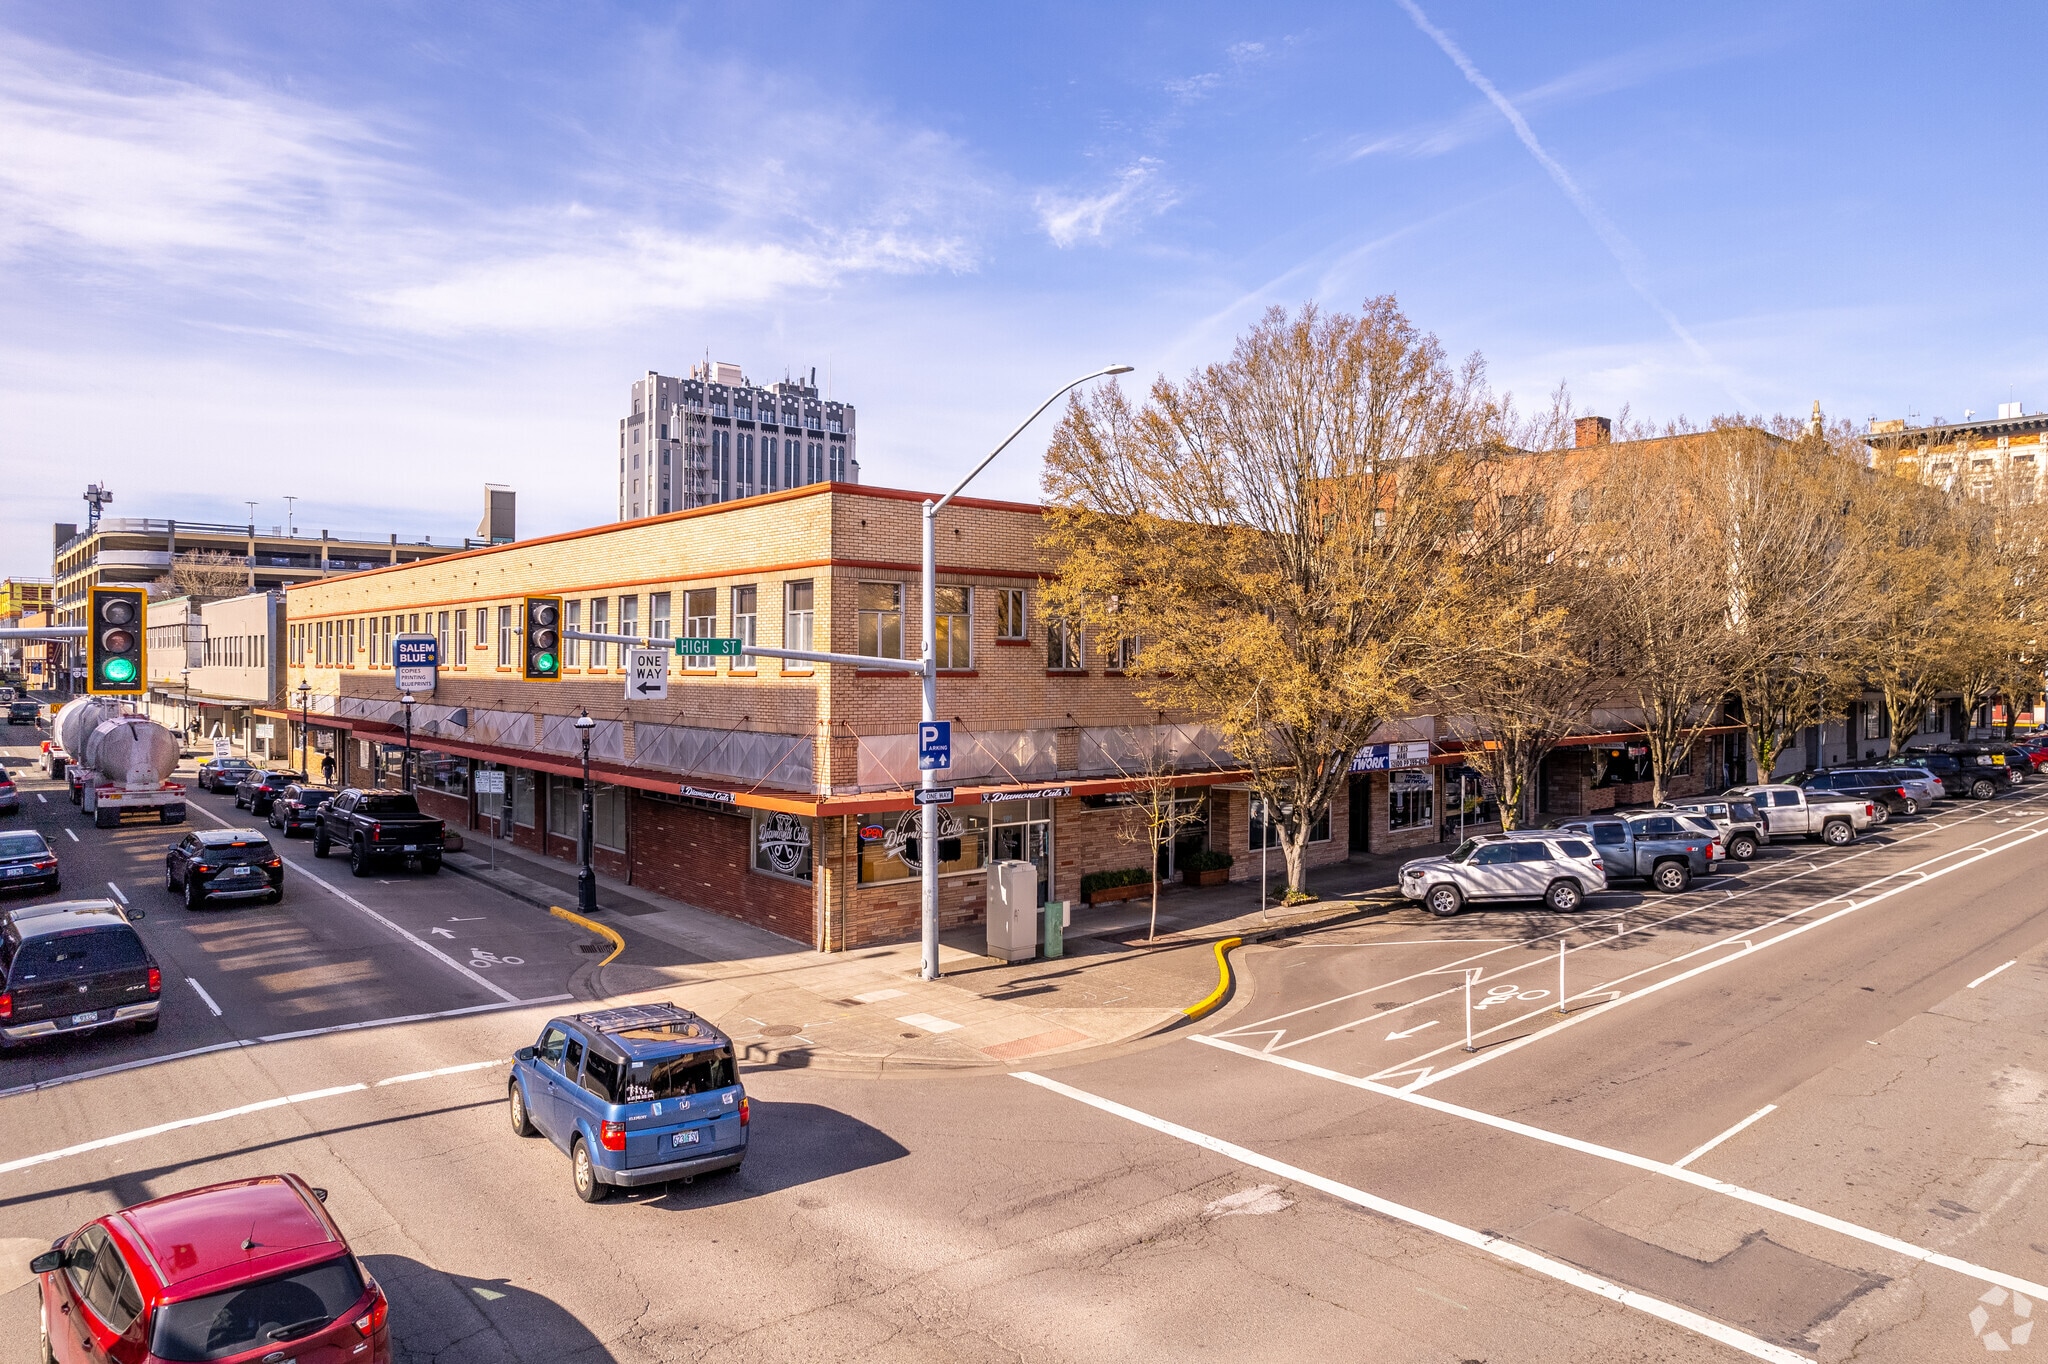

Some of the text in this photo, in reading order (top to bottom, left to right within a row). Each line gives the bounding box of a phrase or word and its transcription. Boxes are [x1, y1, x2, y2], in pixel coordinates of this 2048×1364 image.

[400, 643, 434, 652] SALEM
[681, 640, 737, 654] HIGH ST
[400, 653, 426, 662] BLUE
[638, 656, 661, 666] ONE
[637, 669, 662, 679] WAY
[1355, 746, 1374, 759] VEL
[1348, 756, 1385, 771] TWORK
[685, 786, 729, 802] Diamond Cuts
[926, 791, 950, 800] ONE WAY
[991, 788, 1063, 802] Diamond Cuts
[759, 824, 809, 841] Diamond Cuts
[860, 827, 883, 838] OPEN
[941, 818, 963, 836] Cuts
